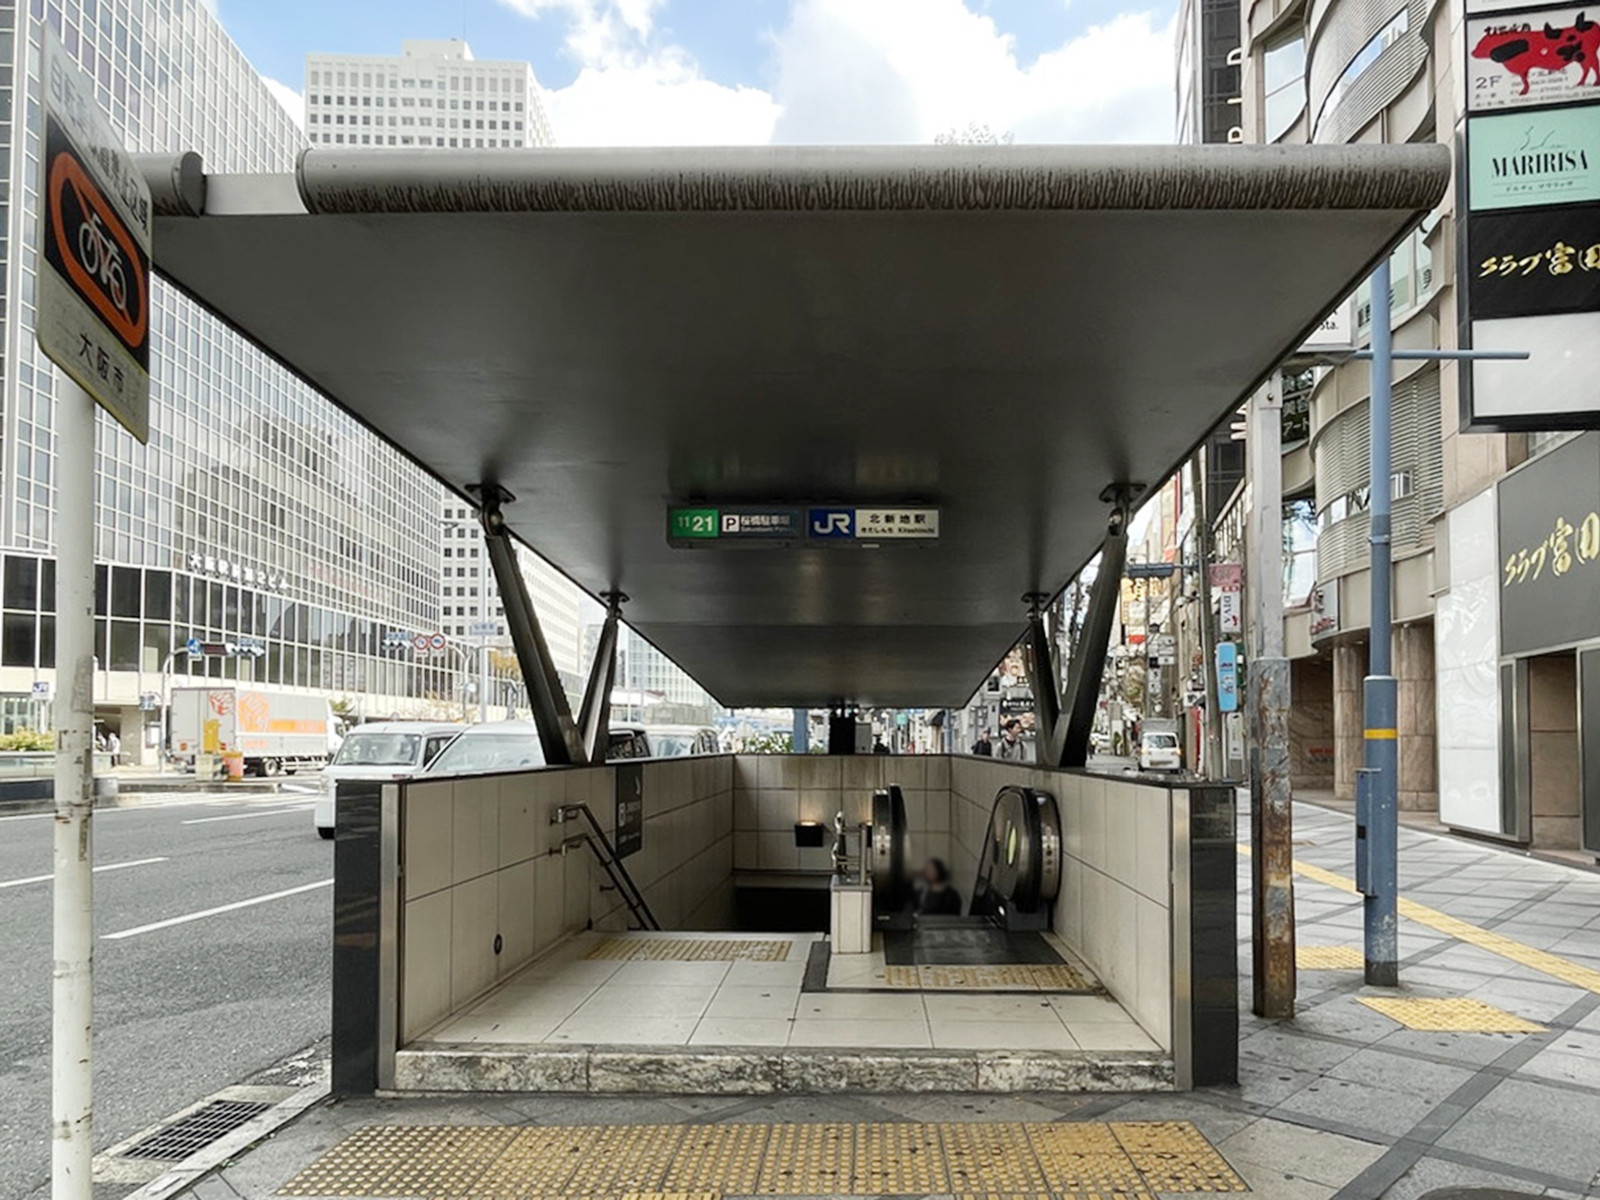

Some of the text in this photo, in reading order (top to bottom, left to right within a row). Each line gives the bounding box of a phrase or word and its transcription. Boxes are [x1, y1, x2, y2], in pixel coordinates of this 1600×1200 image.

[1475, 75, 1502, 89] 2F
[1492, 149, 1588, 178] MARIRISA
[80, 332, 125, 393] 大阪市
[692, 515, 713, 532] 21
[814, 513, 851, 534] JR
[869, 514, 926, 524] 北新地駅
